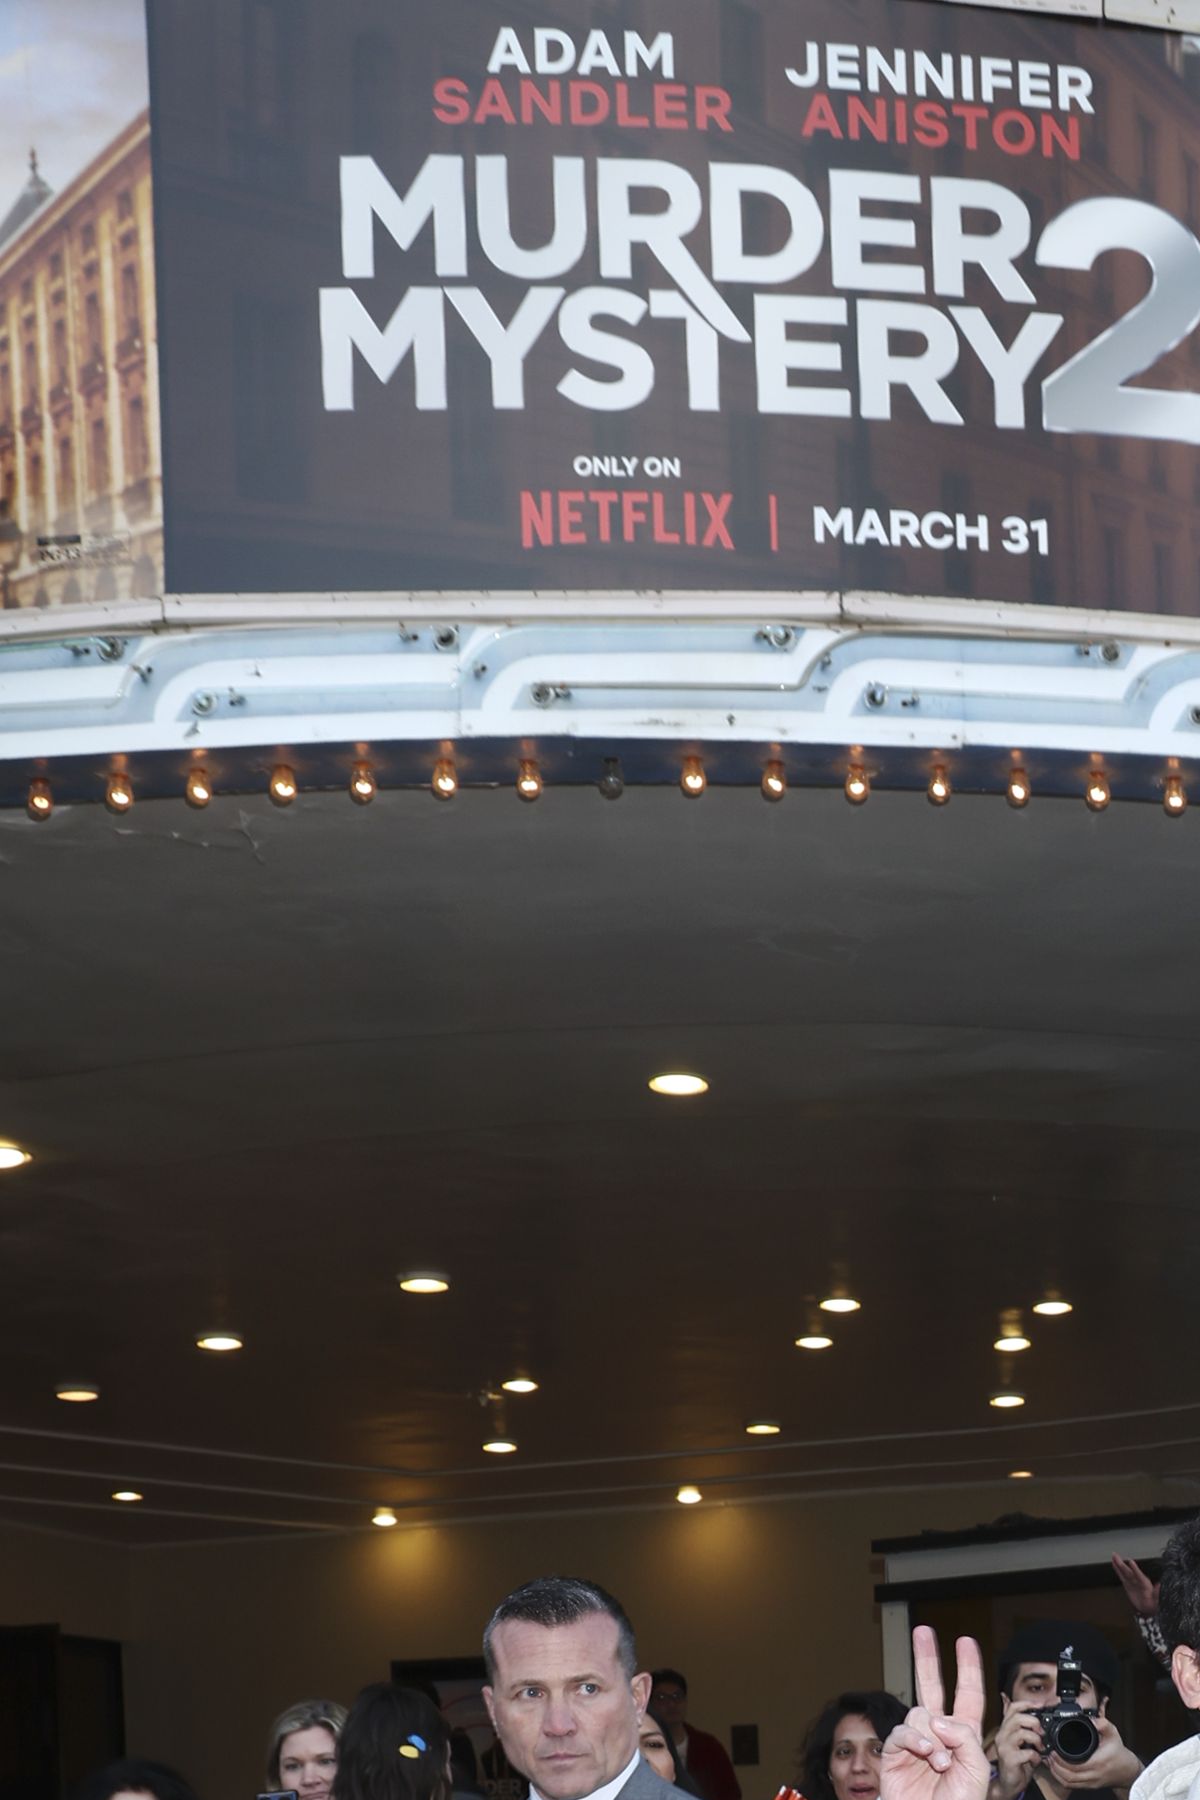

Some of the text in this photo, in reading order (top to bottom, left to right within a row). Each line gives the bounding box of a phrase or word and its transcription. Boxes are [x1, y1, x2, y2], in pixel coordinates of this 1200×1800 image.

[487, 26, 675, 79] ADAM
[784, 41, 1095, 114] JENNIFER
[433, 77, 733, 131] SANDLER
[802, 93, 1081, 161] ANISTON
[339, 153, 1037, 342] MURDER
[318, 286, 1064, 430] MYSTERY
[573, 455, 681, 479] ONLY ON
[520, 489, 1049, 556] NETFLIX MARCH 31
